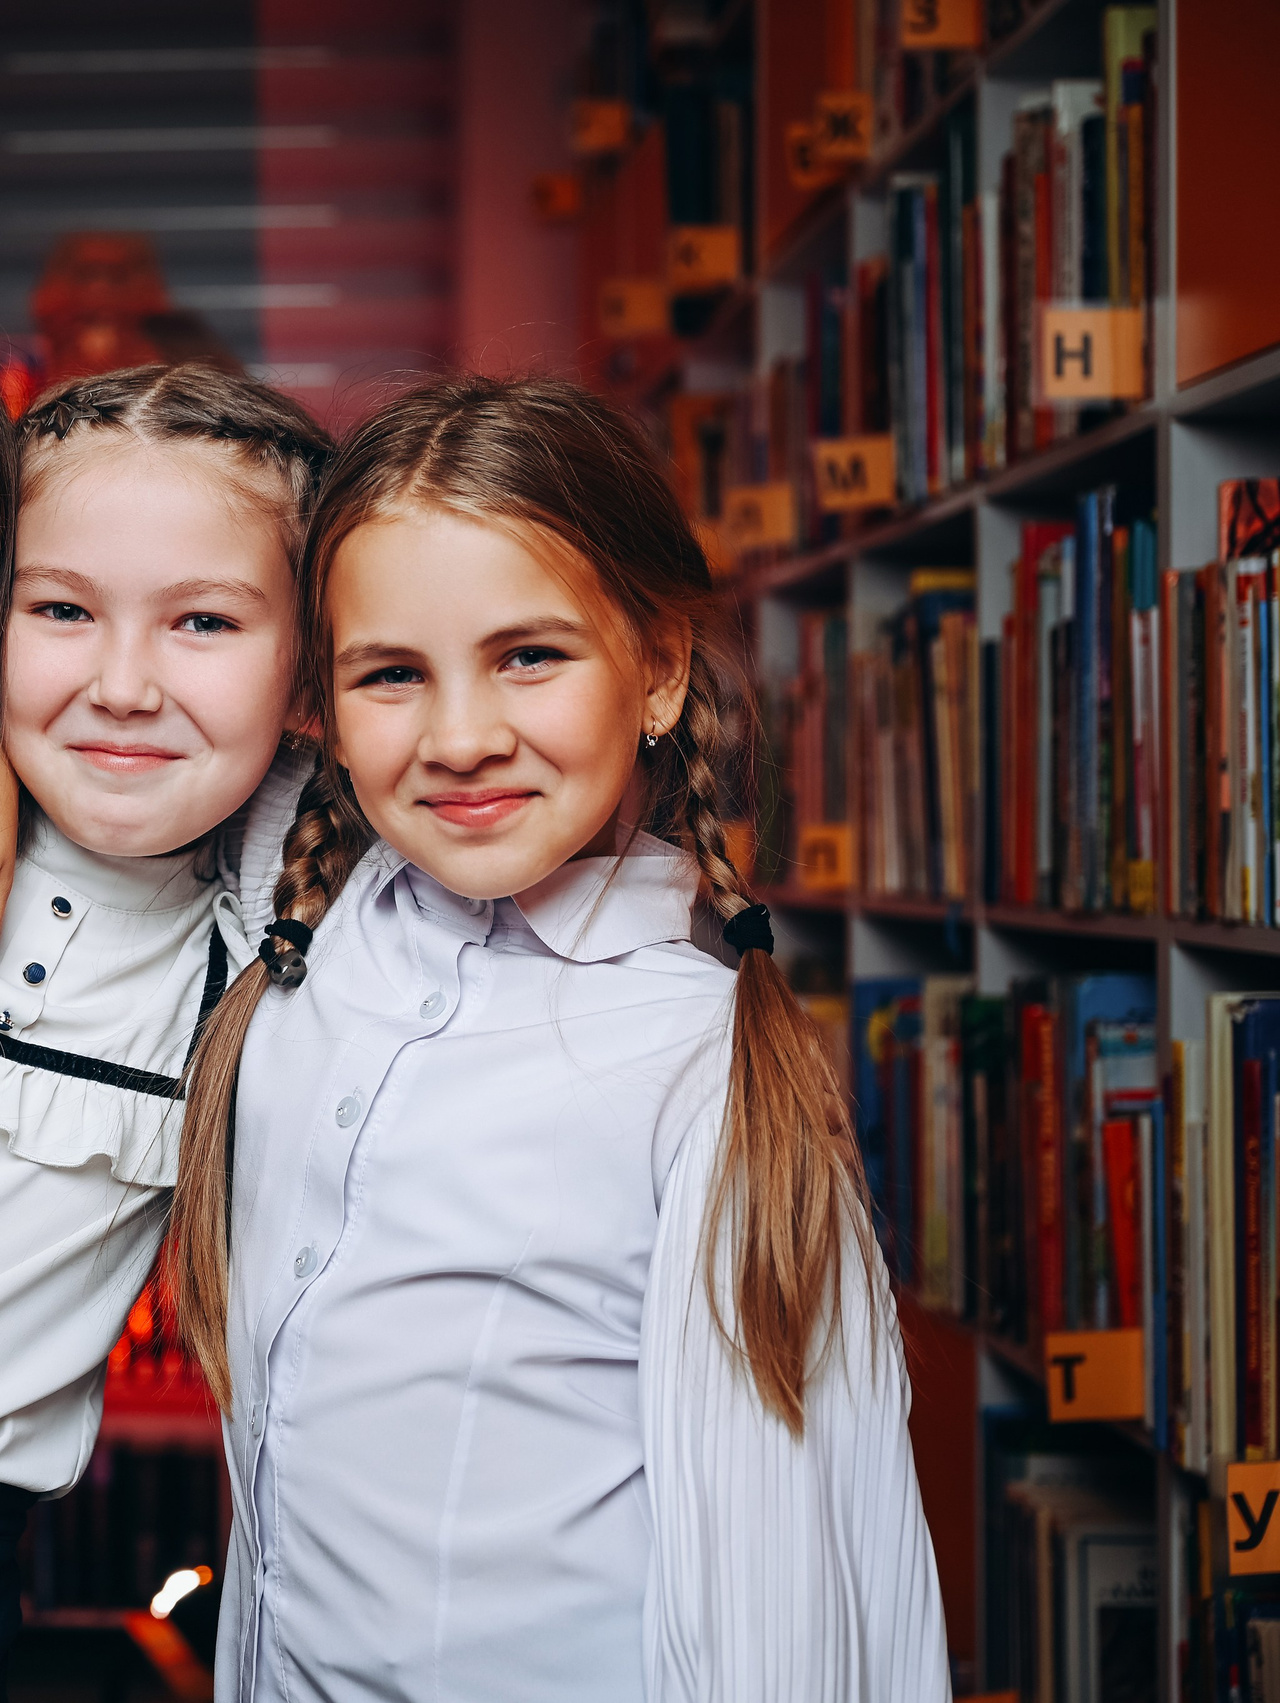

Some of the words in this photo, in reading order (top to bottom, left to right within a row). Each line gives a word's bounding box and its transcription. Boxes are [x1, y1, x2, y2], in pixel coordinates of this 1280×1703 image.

[1054, 331, 1092, 379] Н
[826, 455, 866, 492] М
[1052, 1353, 1087, 1404] Т
[1232, 1490, 1280, 1551] У
